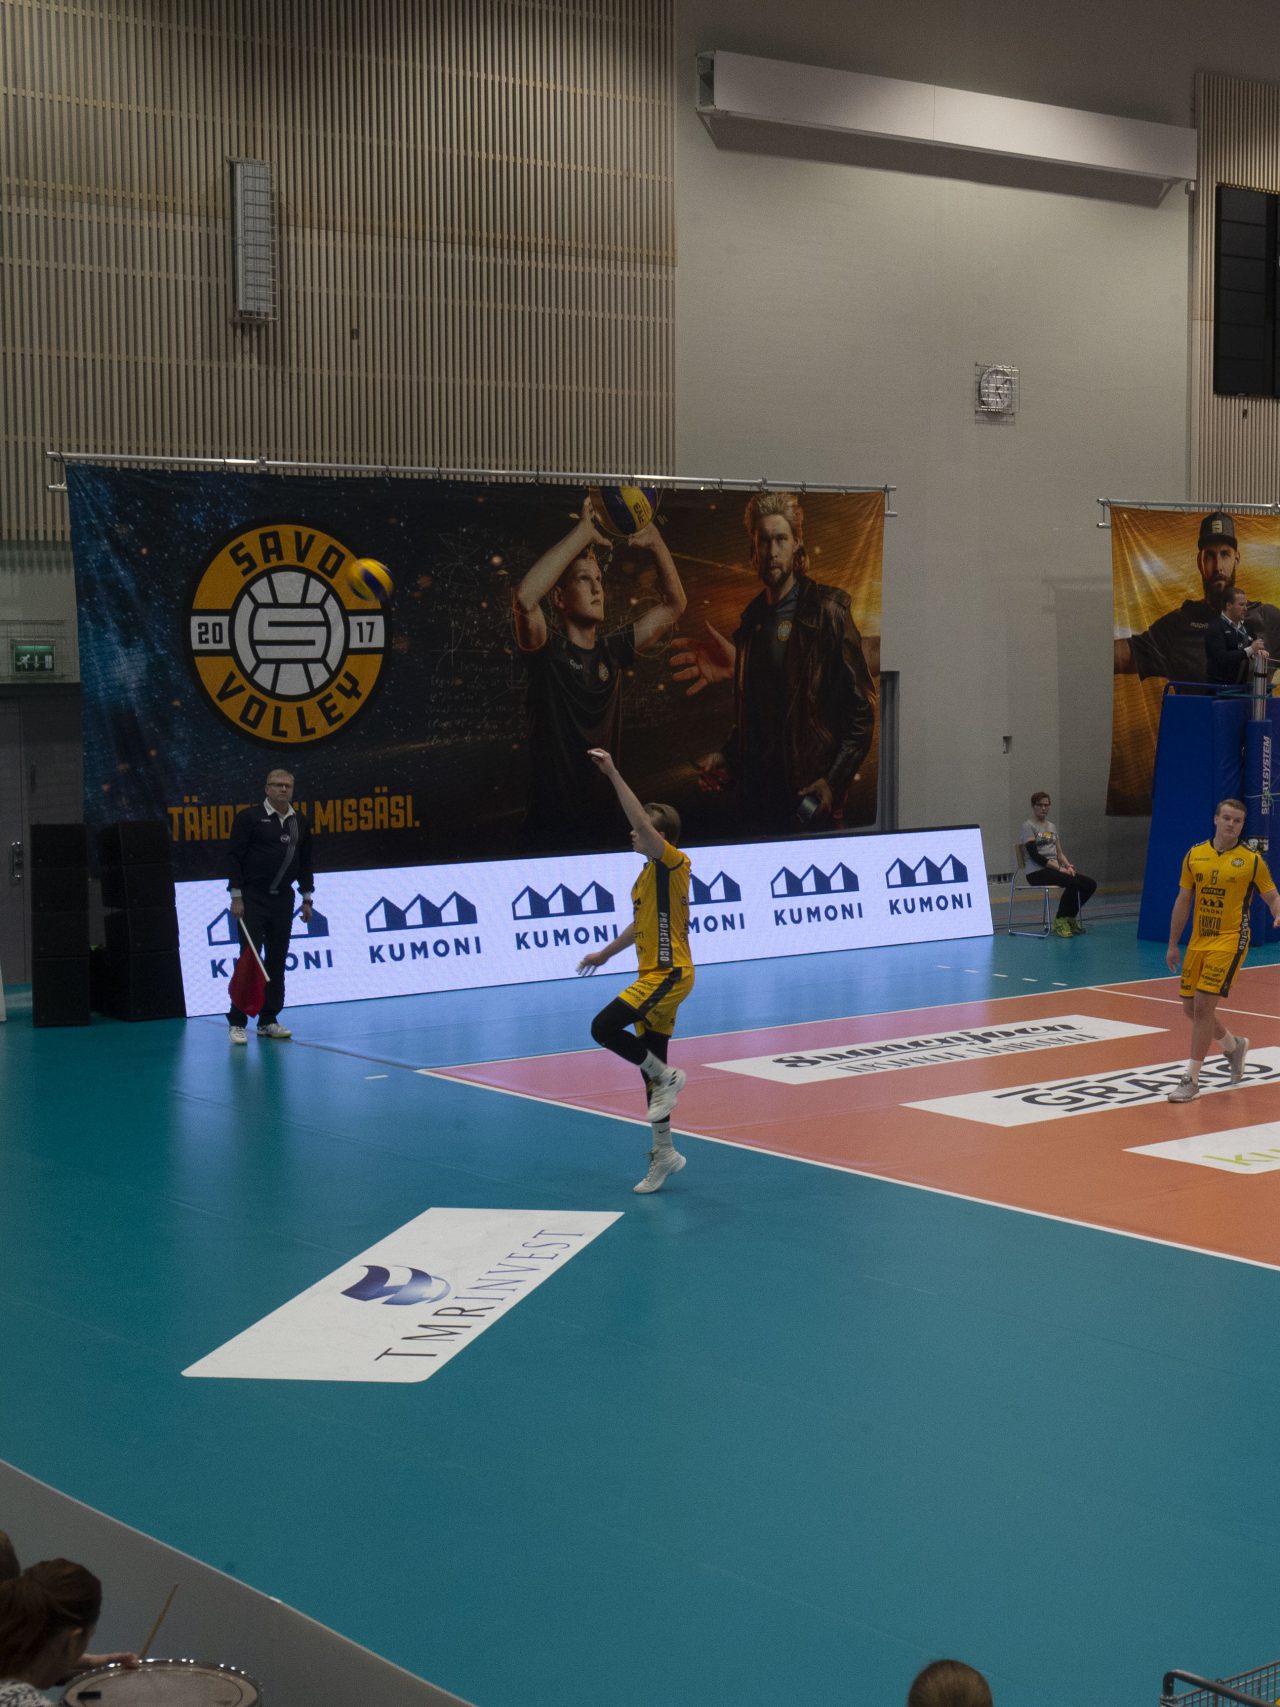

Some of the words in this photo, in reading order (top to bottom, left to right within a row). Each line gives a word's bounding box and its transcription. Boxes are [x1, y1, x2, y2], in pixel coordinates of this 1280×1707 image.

[229, 530, 346, 578] SAVO
[197, 621, 224, 645] 20
[356, 621, 375, 643] 17
[216, 670, 363, 738] VOLLEY
[166, 795, 259, 842] TÄHD
[773, 902, 864, 927] KUMONI
[889, 892, 973, 916] KUMONI
[515, 923, 619, 951] KUMONI
[658, 911, 671, 963] PROJECTICO
[687, 912, 746, 935] MONI
[210, 948, 334, 979] KONI
[369, 935, 483, 965] KUMONI
[772, 1020, 1084, 1070] Suonenjoen
